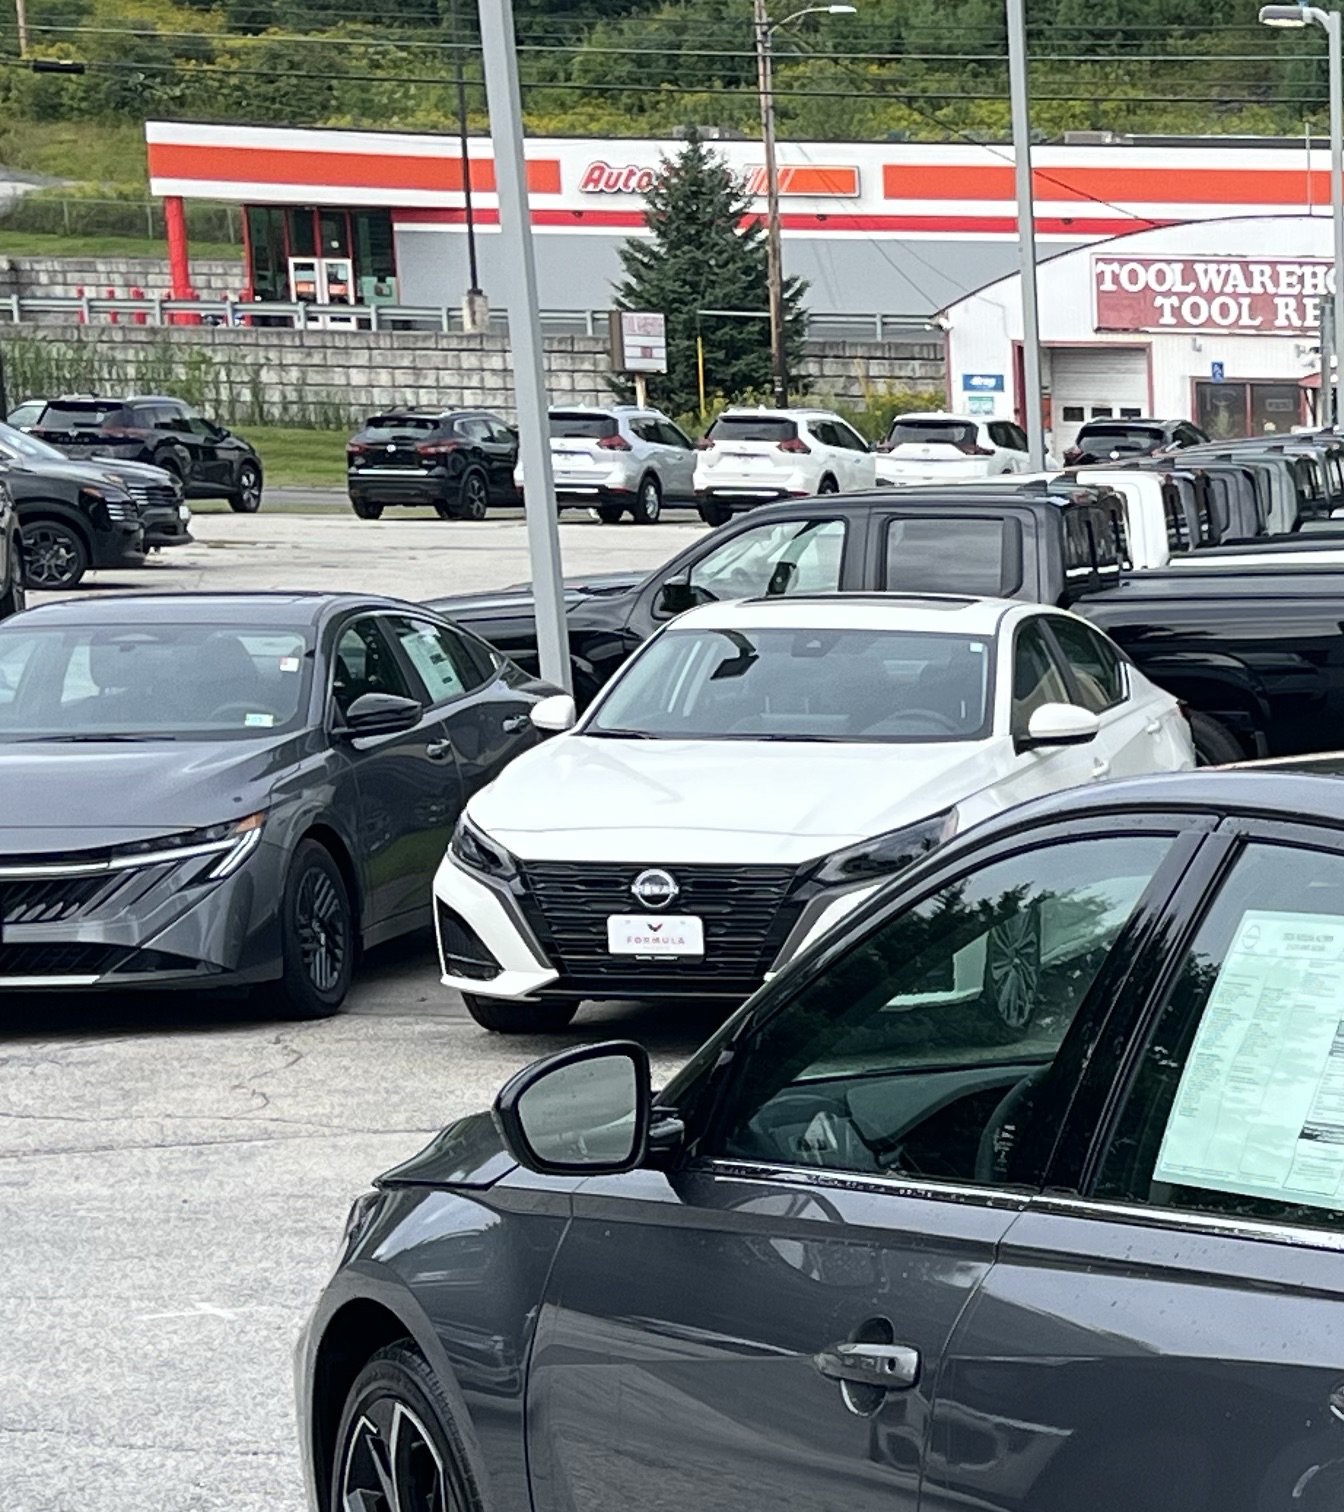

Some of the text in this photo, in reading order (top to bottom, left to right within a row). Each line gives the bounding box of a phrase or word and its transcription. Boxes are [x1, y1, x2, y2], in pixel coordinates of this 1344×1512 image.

[1096, 262, 1196, 293] TOOL
[1154, 295, 1263, 327] TOOL
[626, 936, 685, 945] FORMULA
